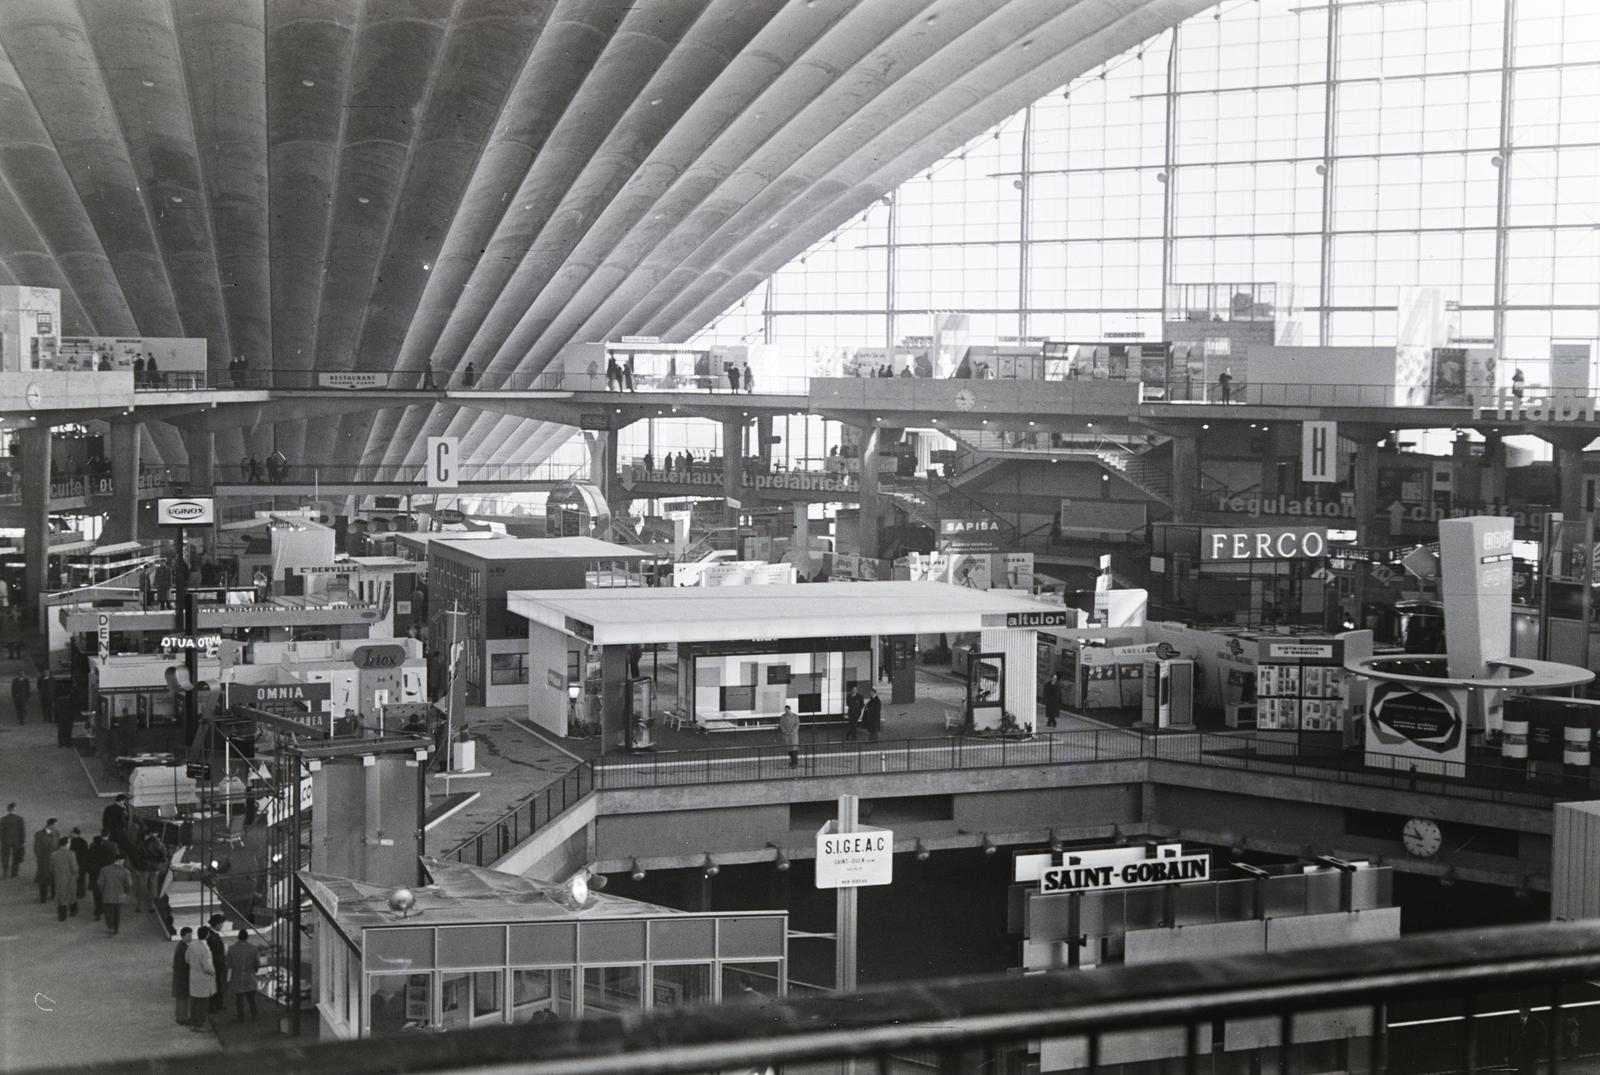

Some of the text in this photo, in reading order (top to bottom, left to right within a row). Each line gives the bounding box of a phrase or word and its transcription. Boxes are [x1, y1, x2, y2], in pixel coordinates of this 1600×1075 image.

[437, 442, 449, 482] C
[1312, 427, 1326, 476] H
[1218, 495, 1357, 518] regulation
[1210, 532, 1323, 559] FERCO
[1008, 612, 1065, 626] altulor
[99, 614, 109, 665] DENY
[257, 687, 303, 700] OMNIA
[825, 837, 885, 854] S.I.G.E.A.C
[1044, 857, 1208, 892] SAINT-GOBAIN
